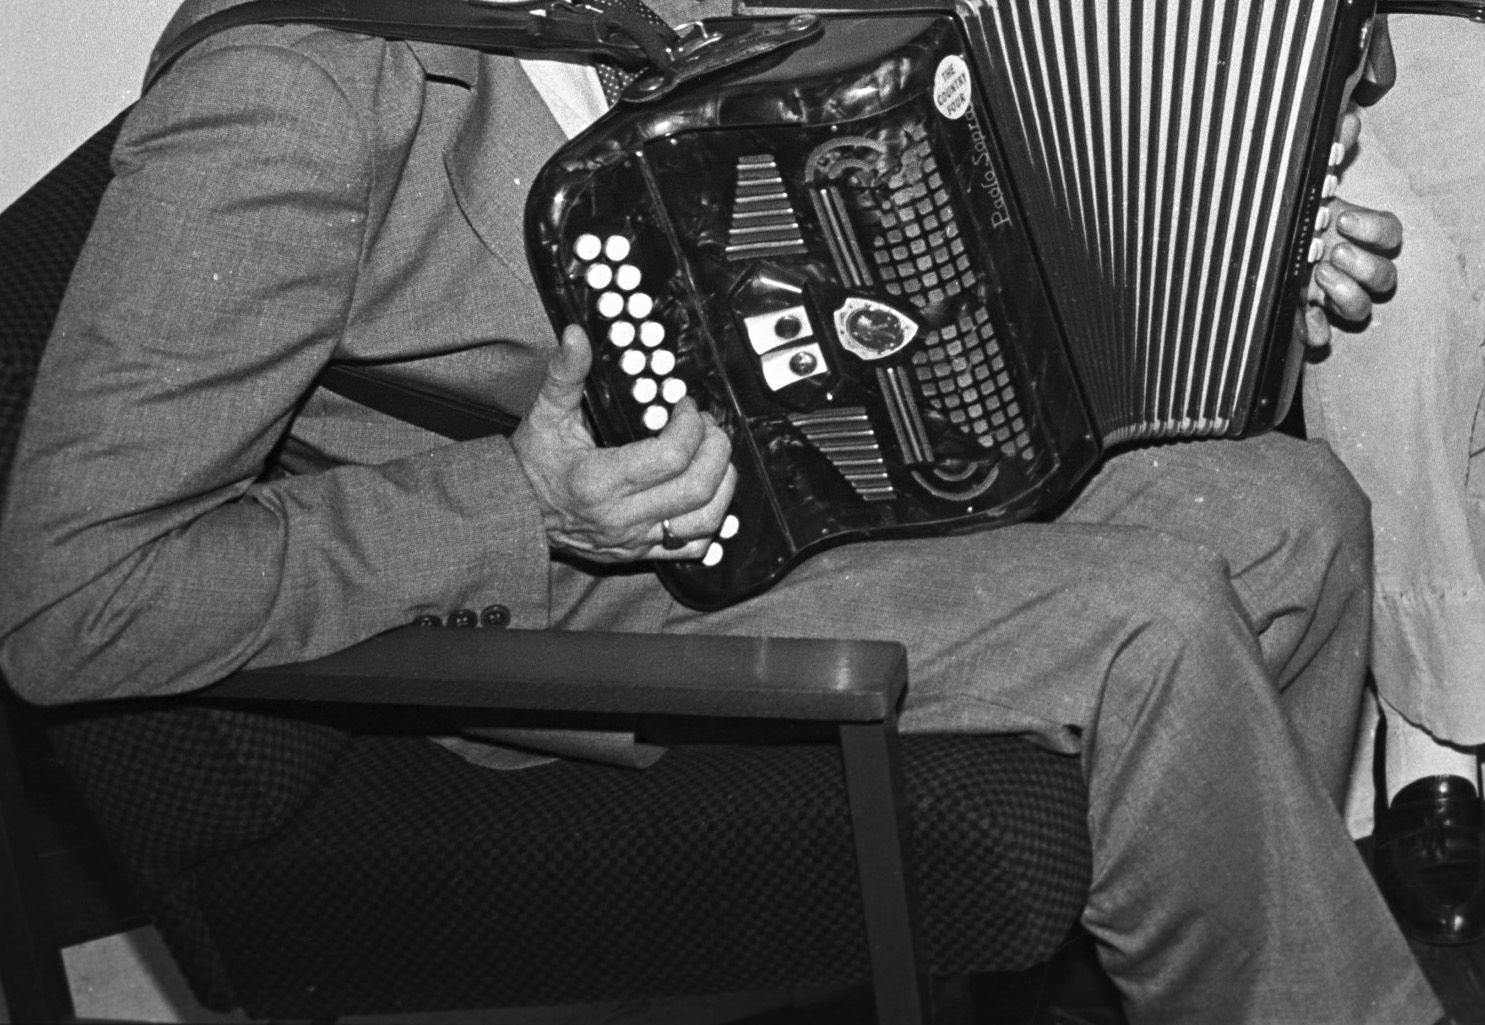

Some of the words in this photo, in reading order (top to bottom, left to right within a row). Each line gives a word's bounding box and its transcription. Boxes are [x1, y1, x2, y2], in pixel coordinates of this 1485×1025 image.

[937, 73, 967, 106] COUNTRY
[941, 64, 955, 83] THE
[947, 93, 966, 115] FOUR
[965, 103, 989, 166] Sopra
[981, 170, 1012, 228] Paolo
